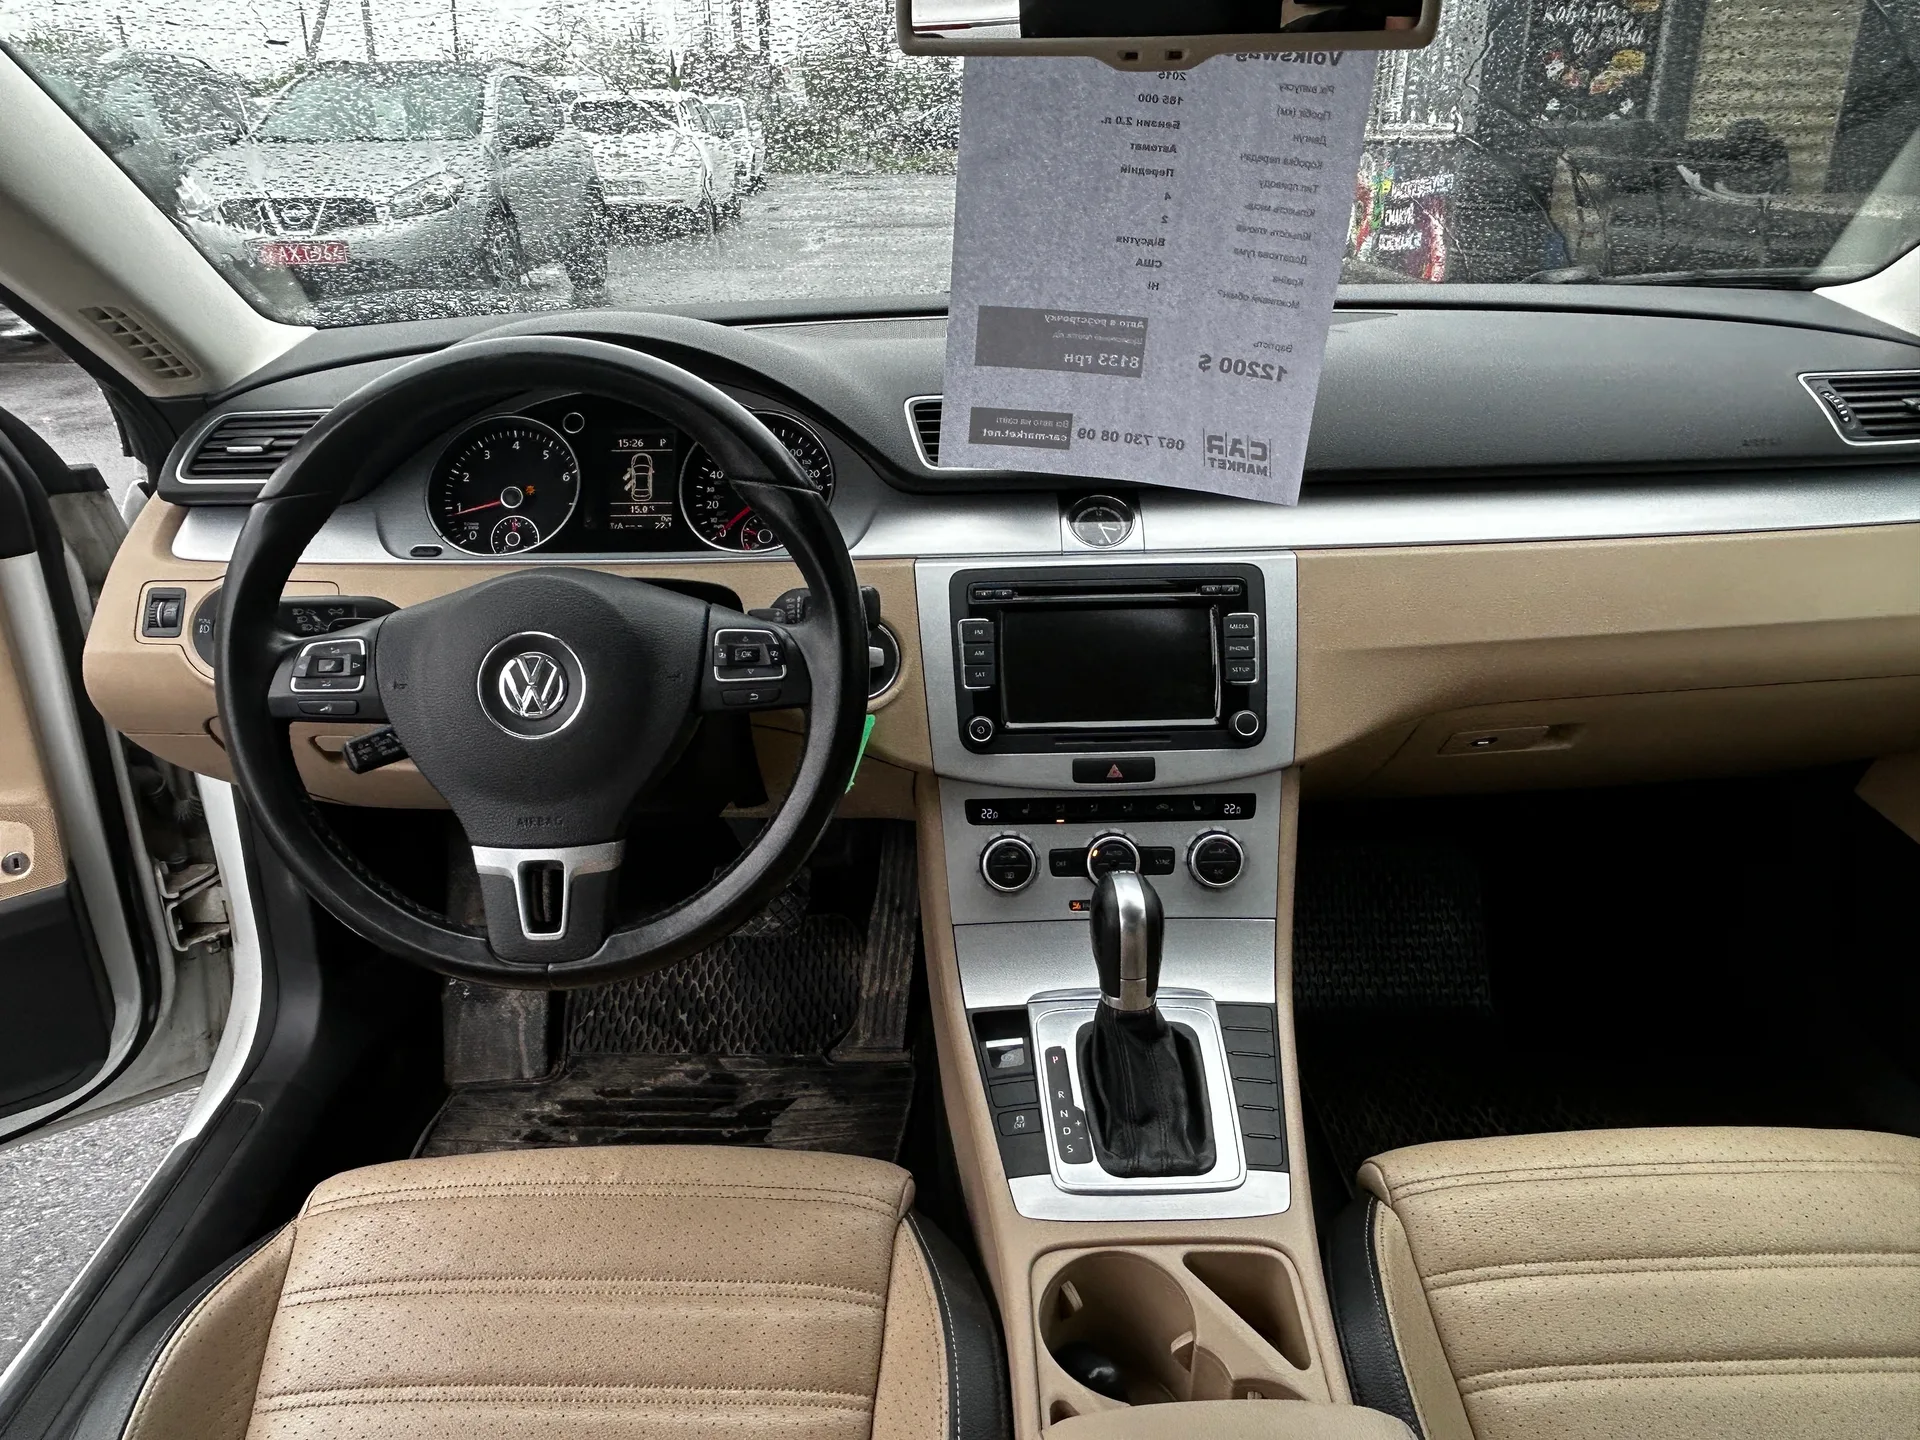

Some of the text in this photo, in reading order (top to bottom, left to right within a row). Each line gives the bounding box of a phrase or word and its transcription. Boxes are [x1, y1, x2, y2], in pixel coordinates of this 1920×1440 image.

[512, 441, 520, 450] 4
[618, 438, 644, 448] 15:26
[659, 438, 667, 447] P
[484, 450, 491, 460] 3
[543, 450, 550, 460] 5
[462, 472, 470, 482] 2
[562, 472, 570, 482] 6
[709, 470, 724, 479] 40
[706, 500, 719, 510] 20
[469, 530, 477, 540] 0
[1052, 1055, 1059, 1064] P
[1058, 1090, 1065, 1099] R
[1060, 1109, 1069, 1118] N
[1063, 1127, 1072, 1135] D
[1066, 1144, 1074, 1153] S
